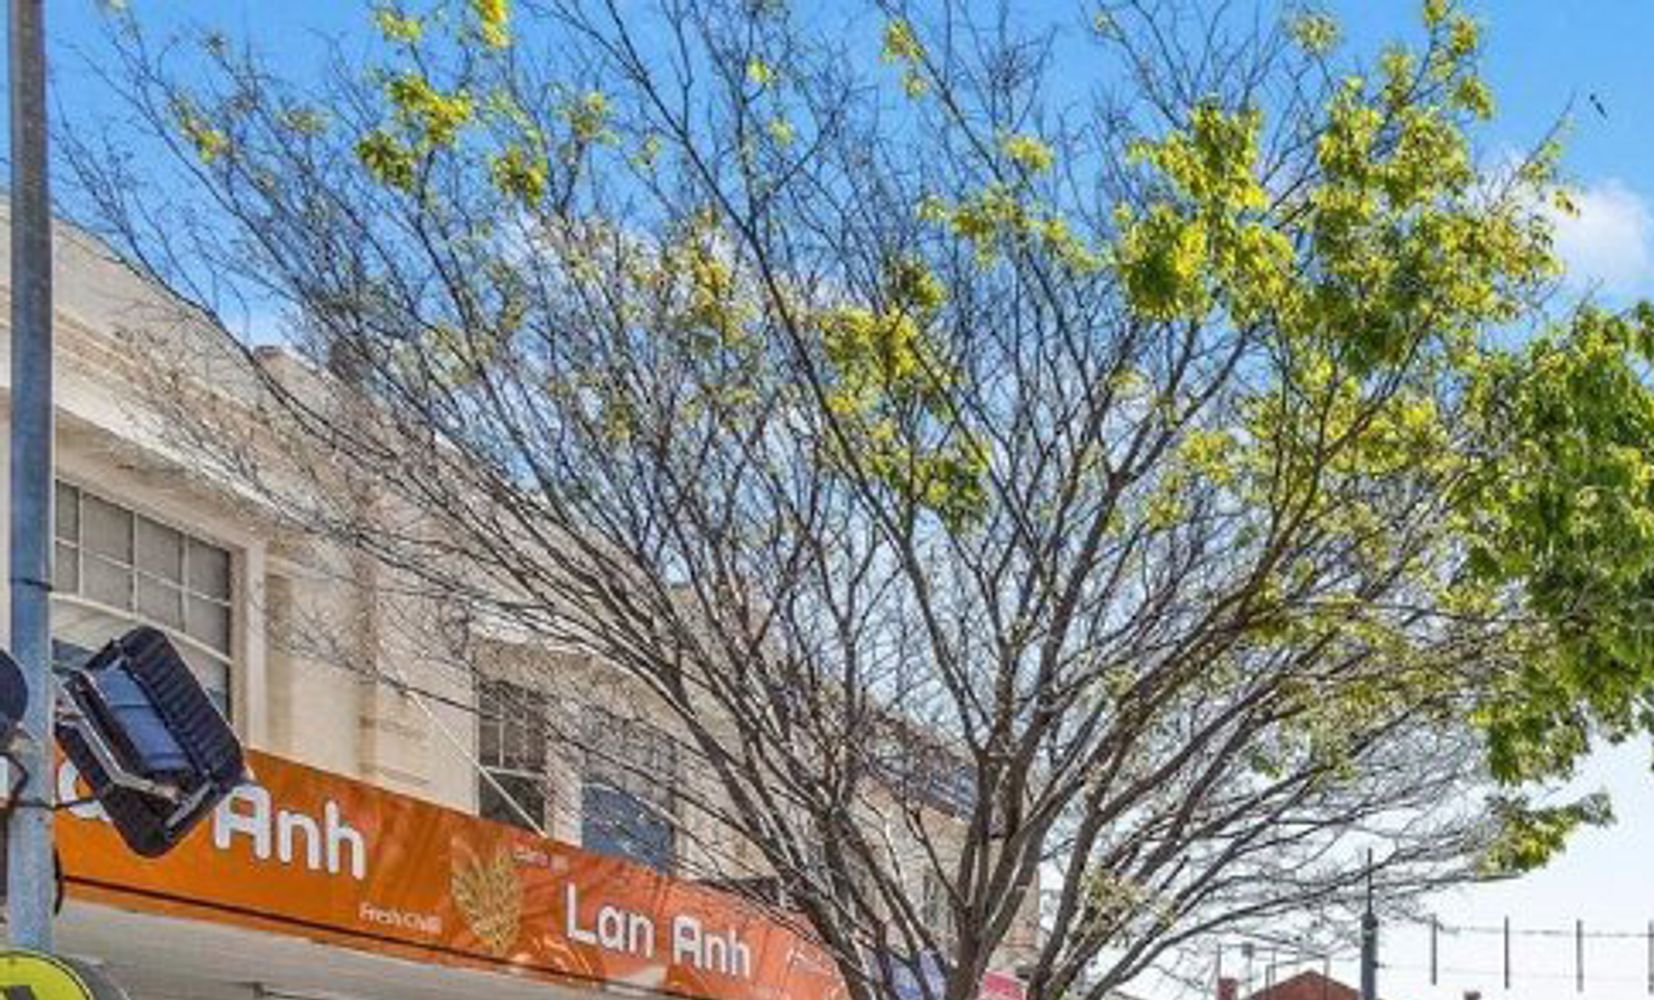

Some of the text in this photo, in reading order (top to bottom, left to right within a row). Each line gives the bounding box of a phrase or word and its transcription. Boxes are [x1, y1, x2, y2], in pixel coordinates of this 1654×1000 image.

[215, 783, 366, 880] Anh
[566, 881, 655, 958] Lan
[673, 914, 750, 979] Anh
